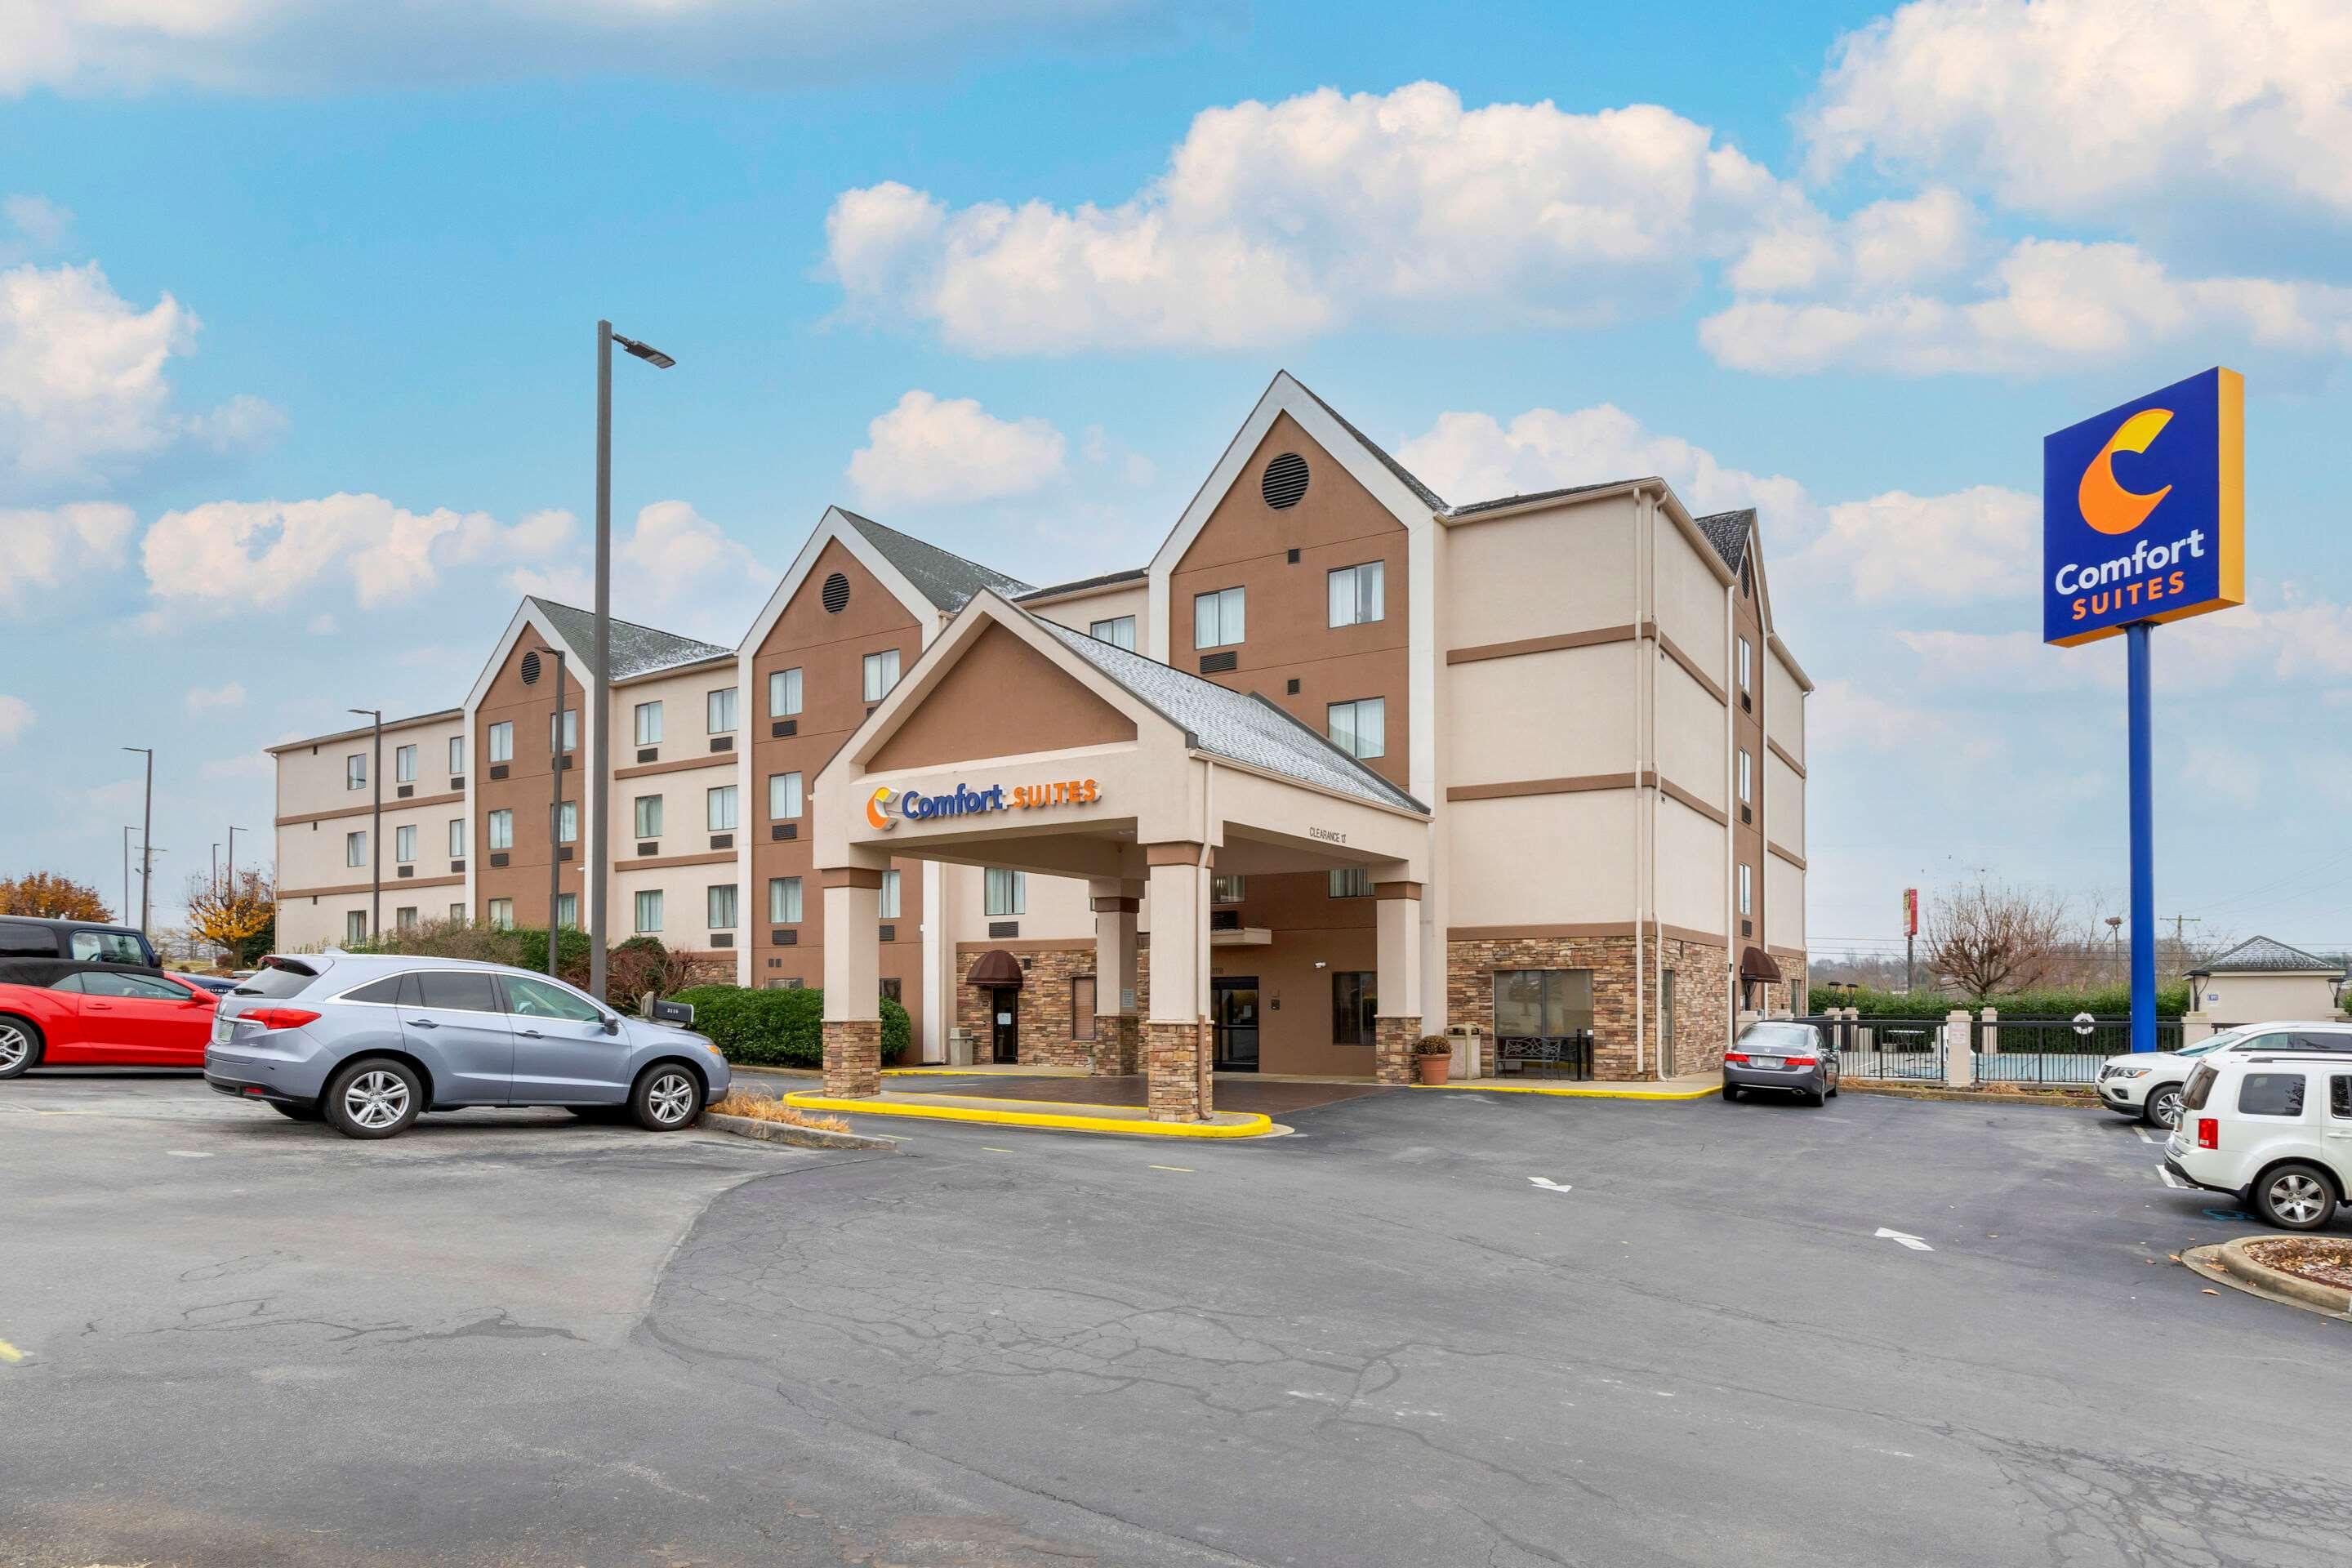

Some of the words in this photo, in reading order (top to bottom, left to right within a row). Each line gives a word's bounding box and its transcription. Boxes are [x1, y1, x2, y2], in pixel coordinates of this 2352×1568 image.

[2055, 529, 2204, 595] Comfort
[2072, 571, 2184, 620] SUITES
[902, 783, 1004, 819] Comfort
[1013, 778, 1100, 808] SUITES
[1309, 826, 1339, 842] CLEARANCE
